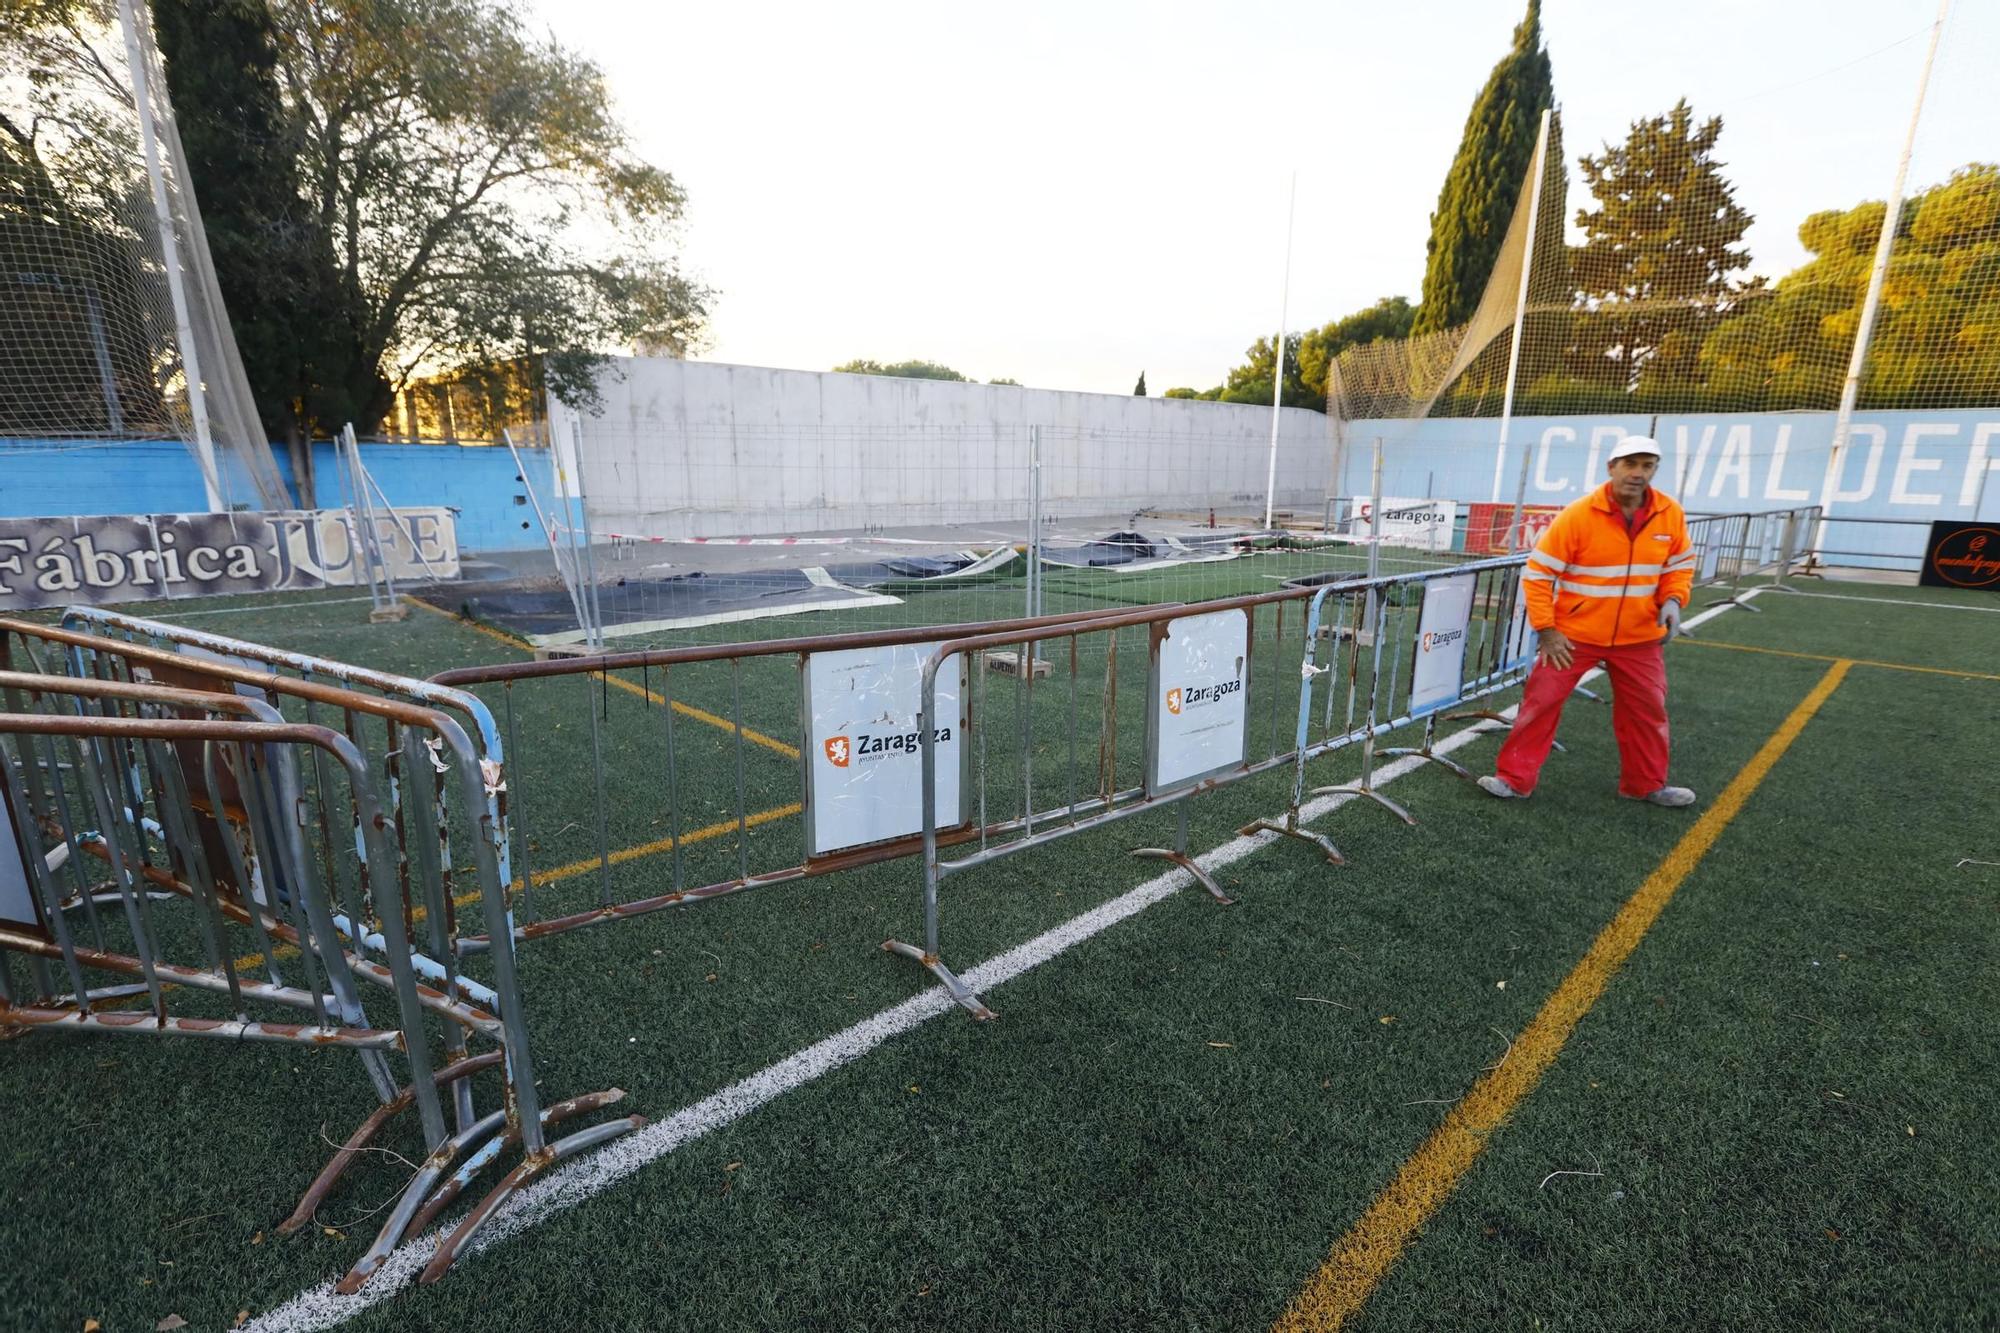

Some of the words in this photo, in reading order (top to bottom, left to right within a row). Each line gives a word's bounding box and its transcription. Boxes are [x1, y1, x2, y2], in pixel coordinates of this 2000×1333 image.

[1386, 508, 1445, 525] Zaragoza
[0, 530, 261, 596] Fábrica
[265, 513, 458, 590] JUFE
[1432, 630, 1462, 646] Zaragoza
[1185, 679, 1240, 704] Zaragoza
